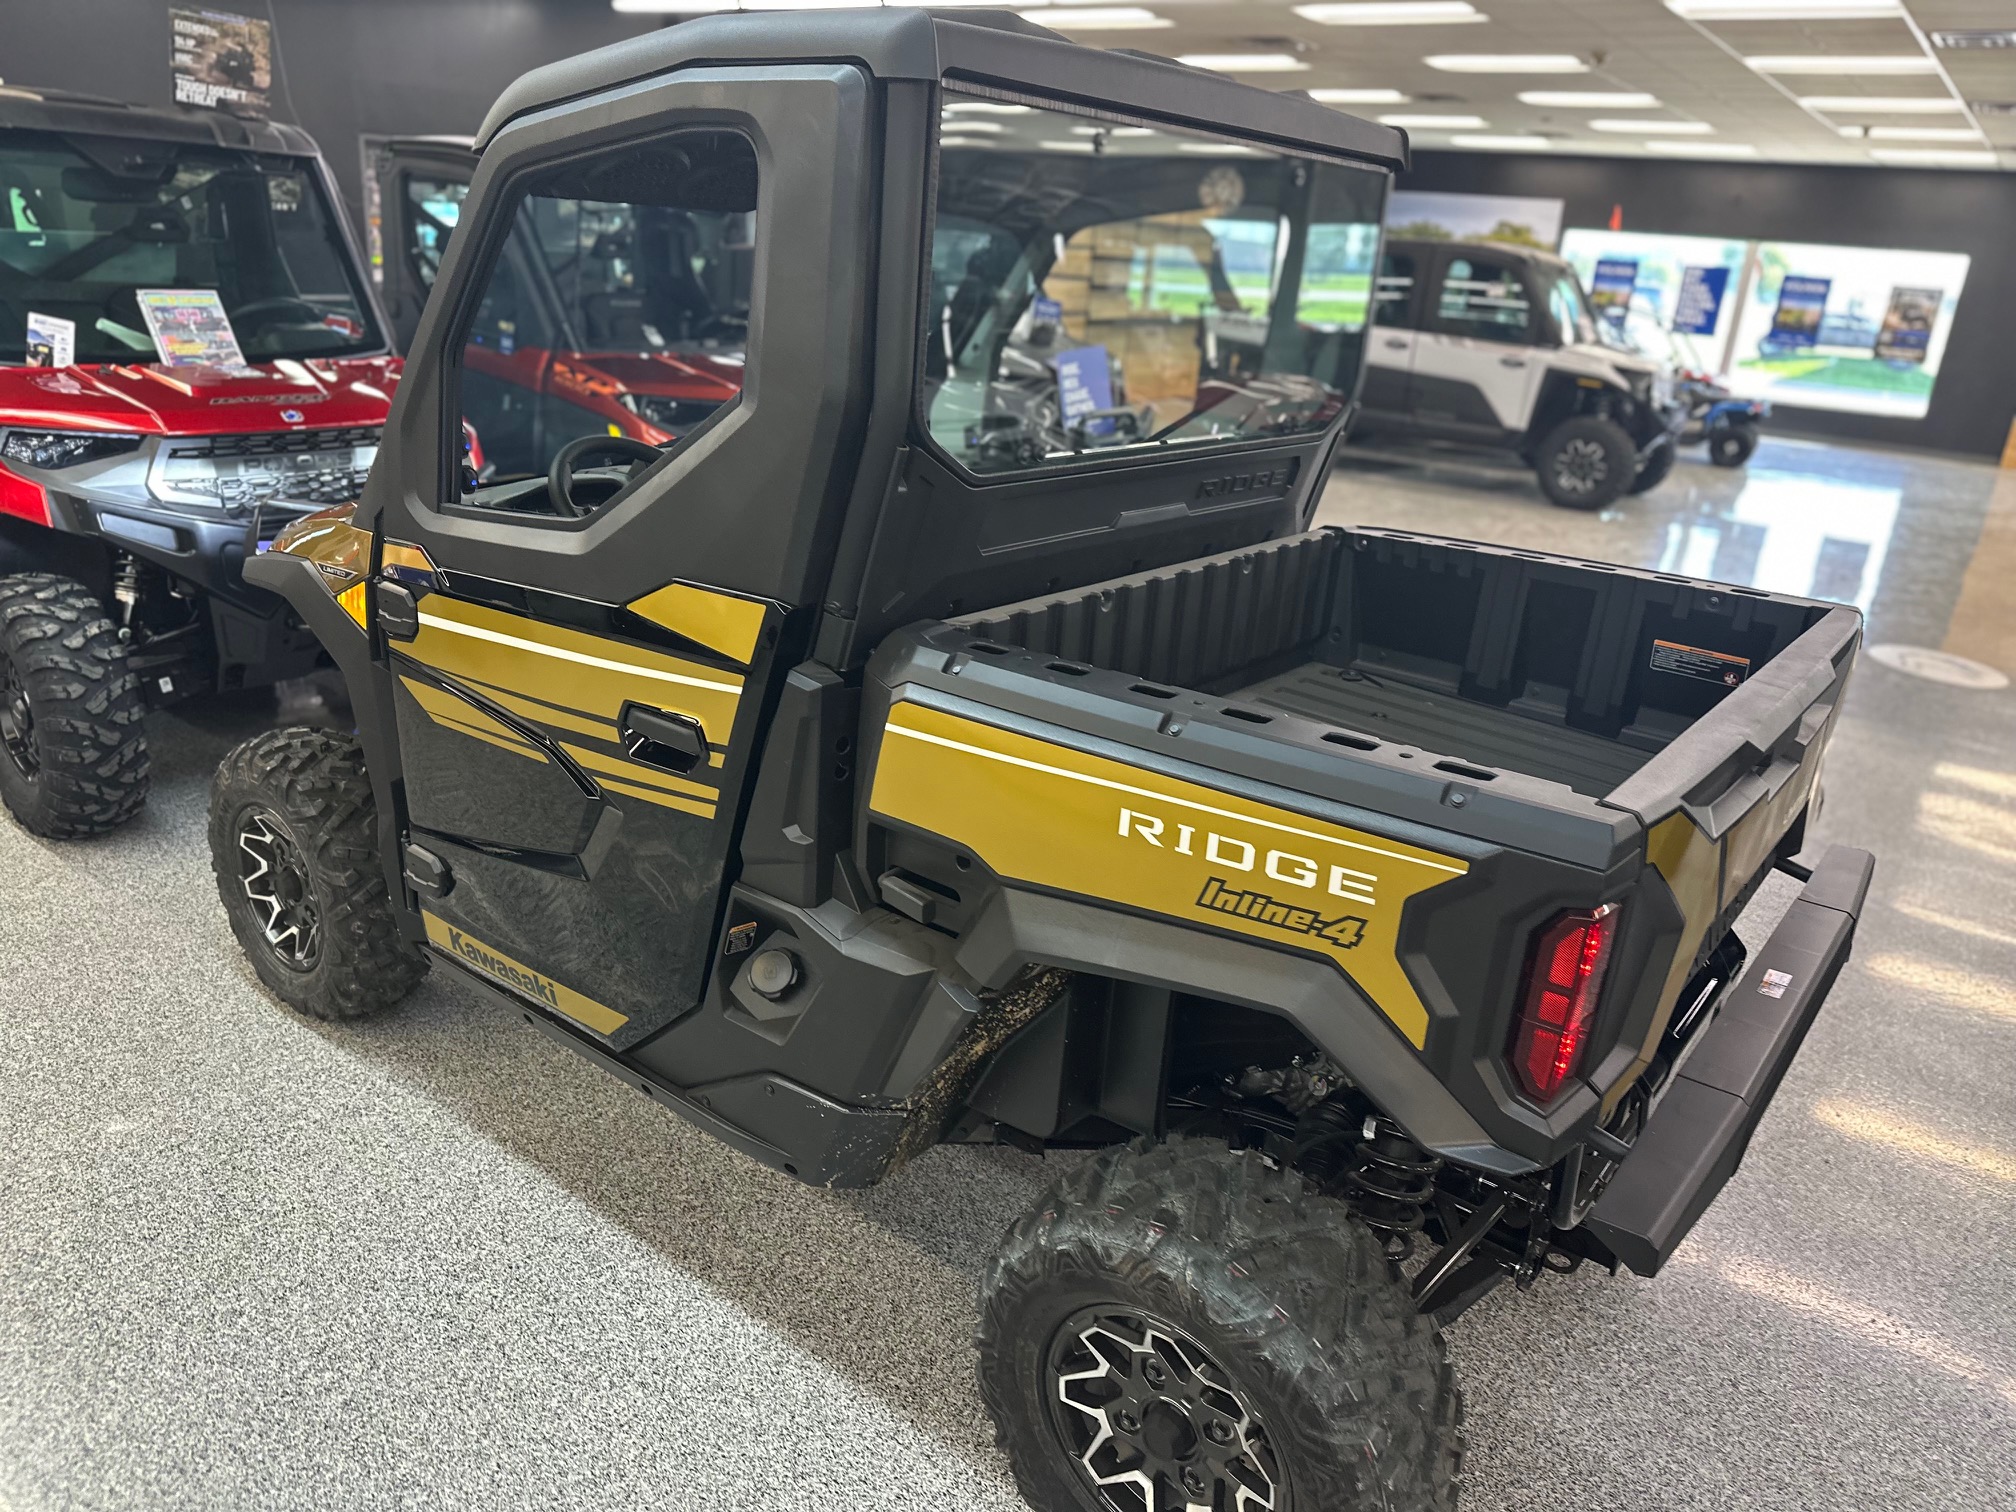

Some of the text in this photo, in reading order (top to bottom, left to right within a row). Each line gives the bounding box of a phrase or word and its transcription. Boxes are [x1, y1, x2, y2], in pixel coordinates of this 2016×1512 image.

[176, 79, 207, 95] TOUGH
[1196, 469, 1287, 498] RIDGE
[322, 565, 347, 577] LIMITED
[1118, 807, 1378, 906] RIDGE
[1195, 876, 1368, 949] Inline-4
[448, 926, 558, 1006] Kawasaki
